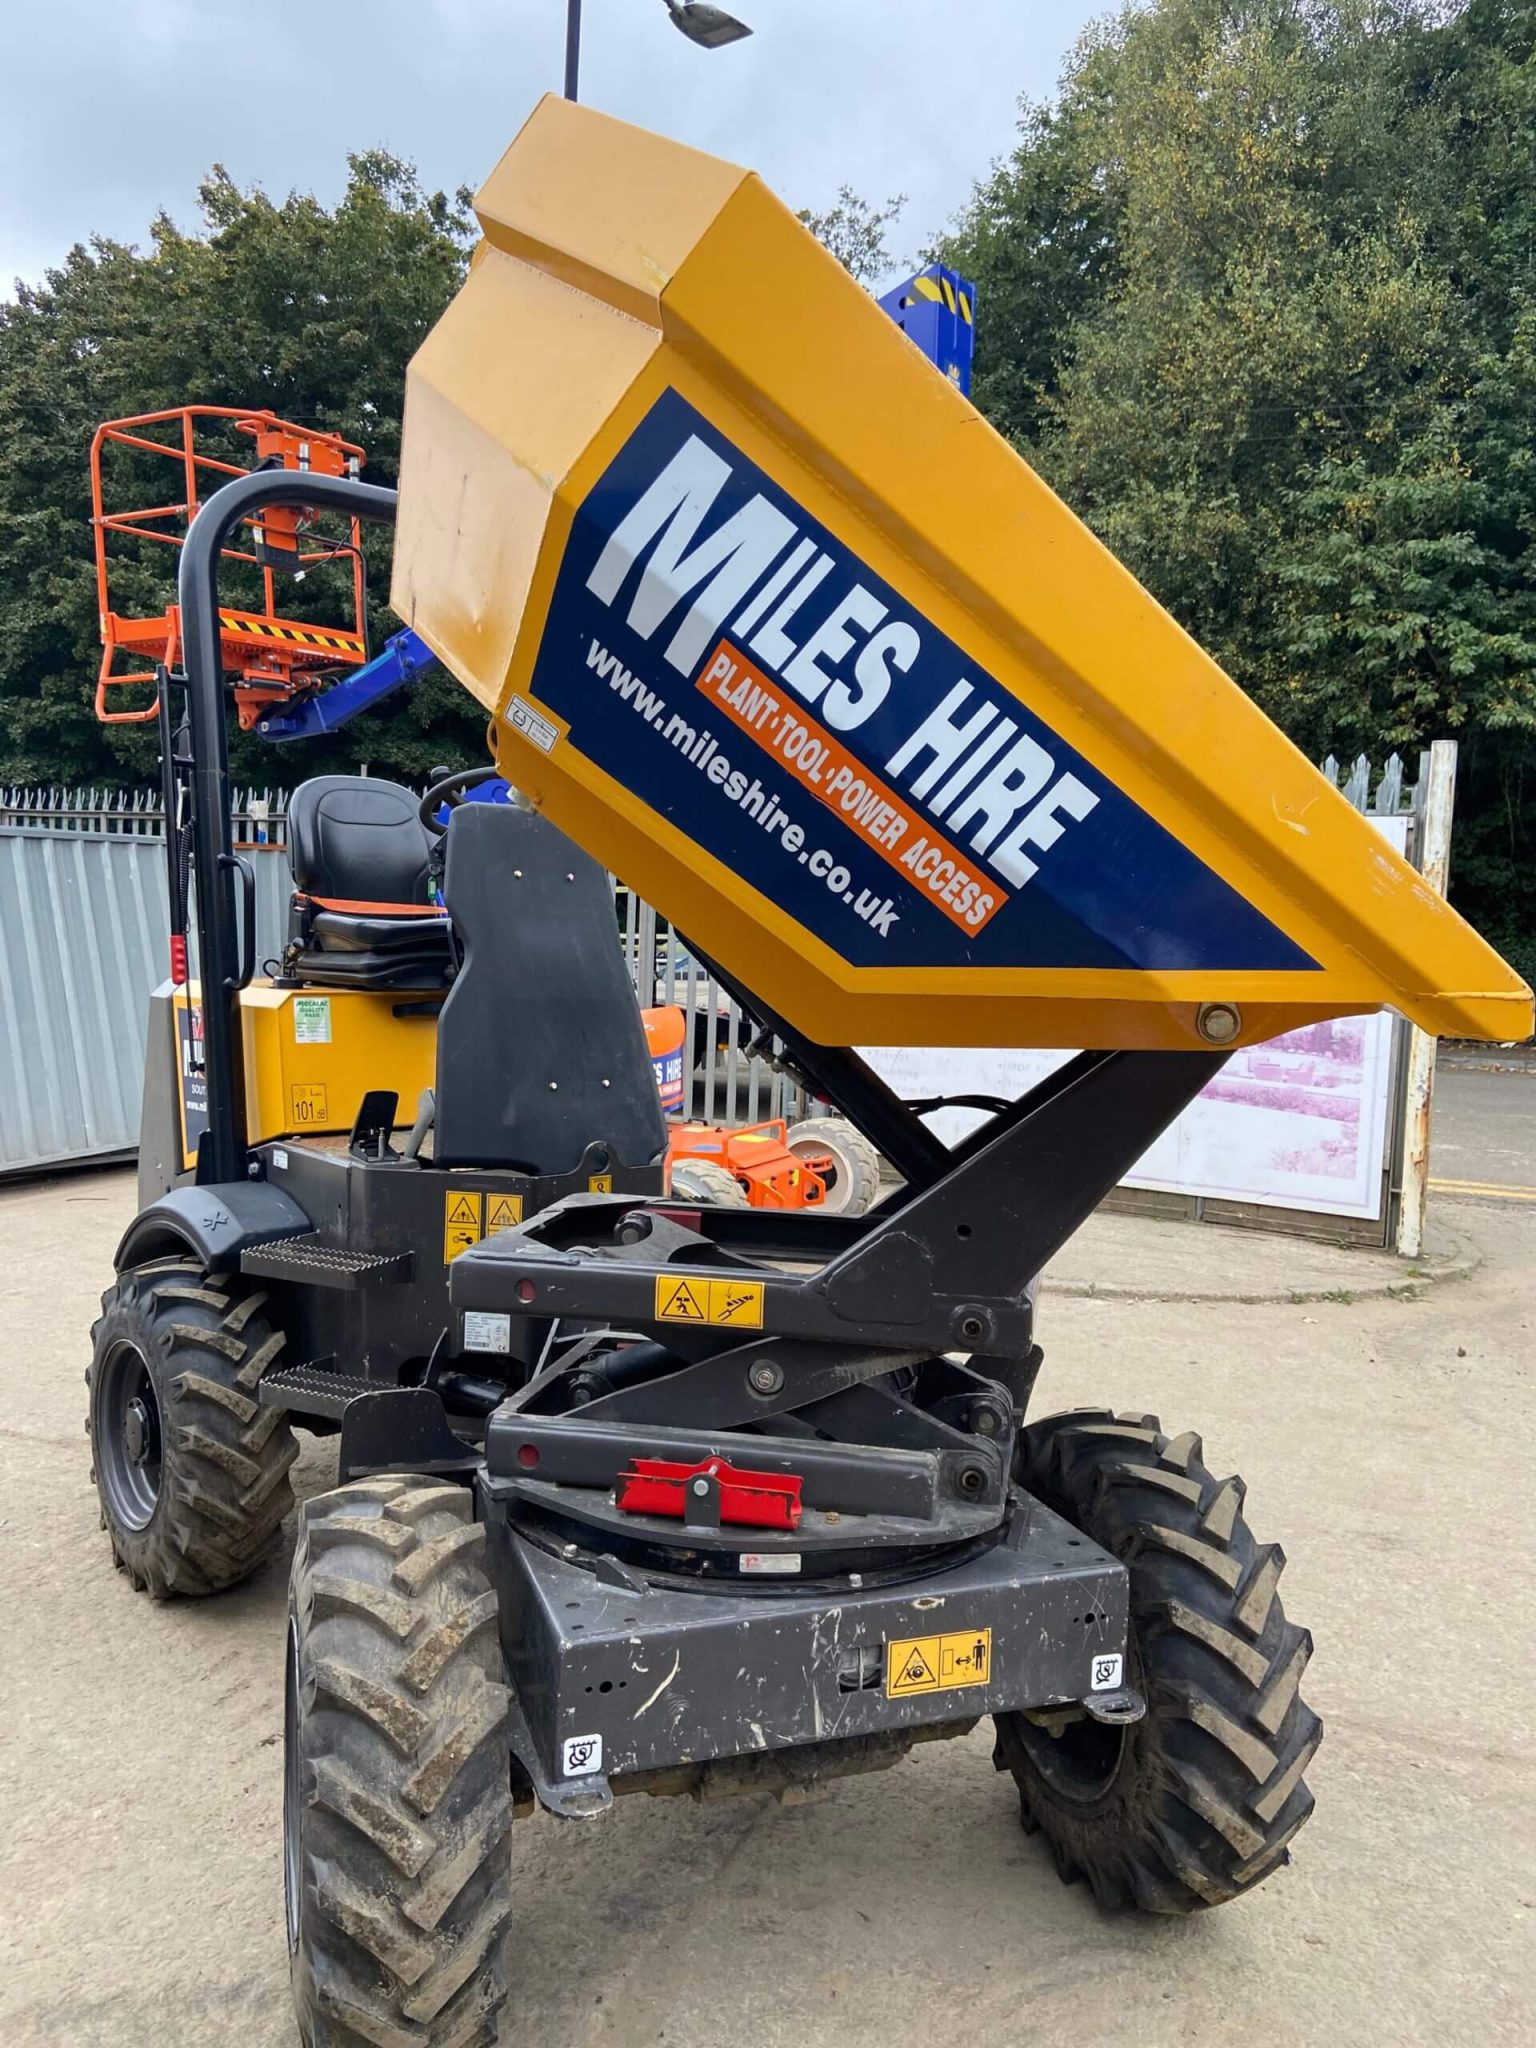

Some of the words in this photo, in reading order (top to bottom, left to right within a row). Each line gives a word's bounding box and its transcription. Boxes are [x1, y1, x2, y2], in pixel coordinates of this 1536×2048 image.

[585, 433, 921, 731] MILES
[884, 677, 1101, 890] HIRE
[585, 638, 900, 938] www.mileshire.co.uk
[899, 837, 994, 925] ACCESS
[295, 1100, 314, 1120] 101
